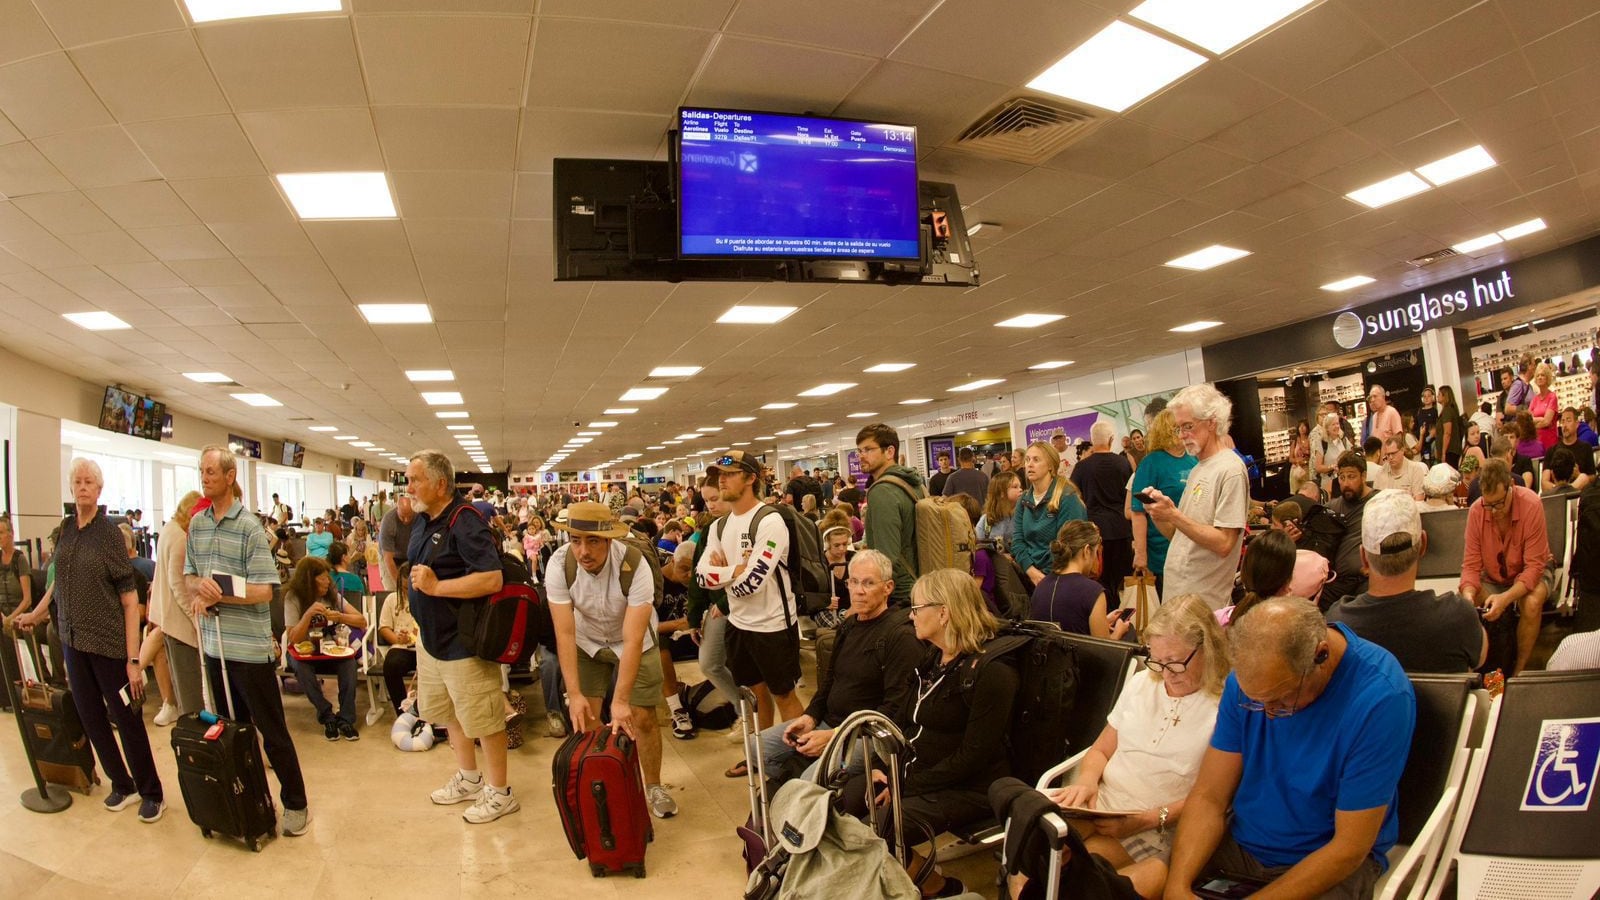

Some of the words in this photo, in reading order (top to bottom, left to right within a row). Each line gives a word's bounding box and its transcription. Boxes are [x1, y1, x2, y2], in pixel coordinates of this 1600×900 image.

[883, 130, 912, 142] 13:14
[1366, 291, 1469, 335] sunglass
[1472, 270, 1515, 307] hut
[951, 413, 965, 424] DUTY
[965, 411, 979, 421] FREE
